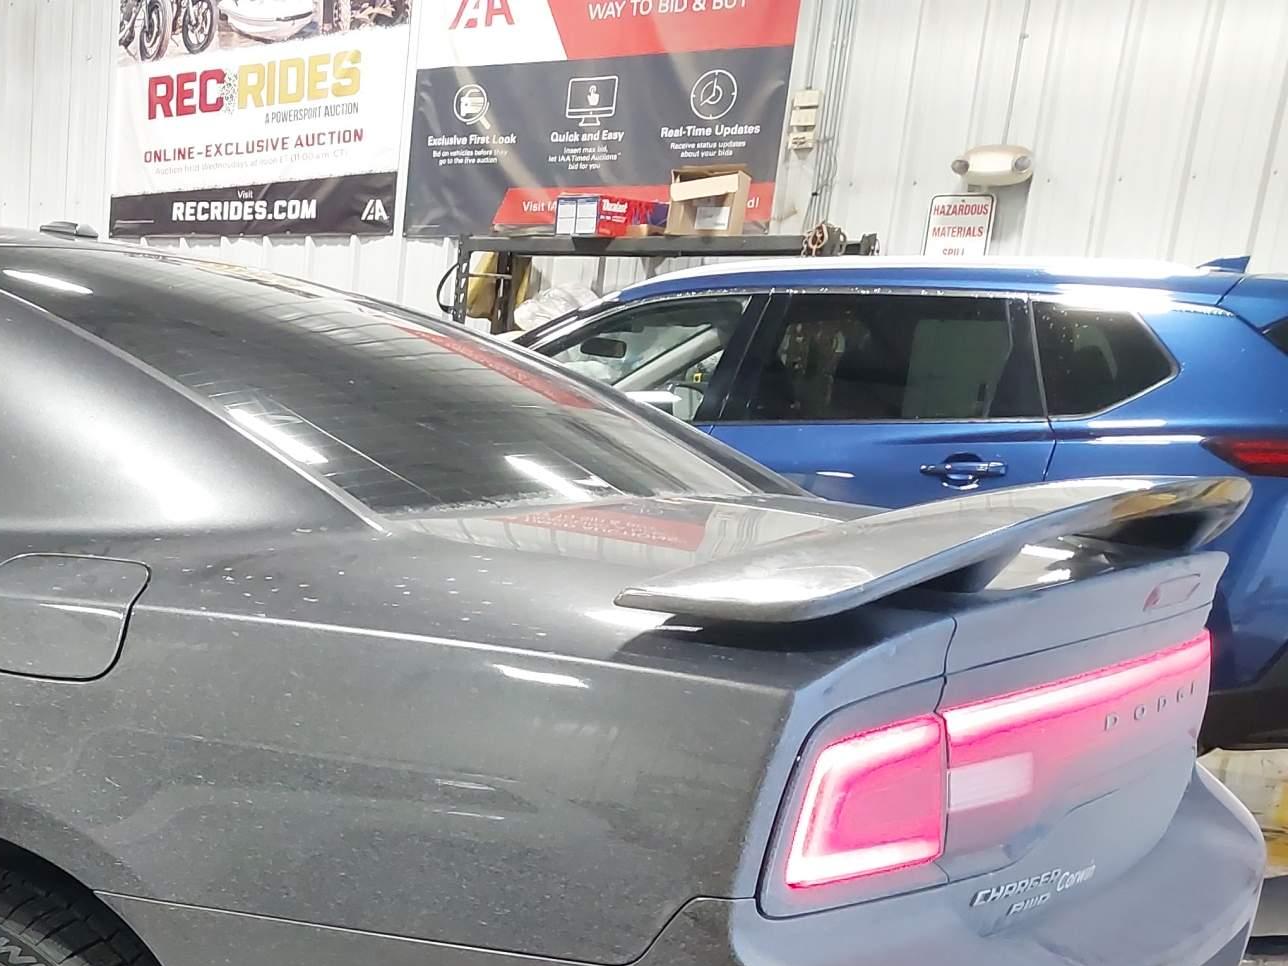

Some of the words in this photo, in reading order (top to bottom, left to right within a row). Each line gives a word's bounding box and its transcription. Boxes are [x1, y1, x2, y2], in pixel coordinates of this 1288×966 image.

[588, 1, 626, 20] WAY
[630, 0, 652, 17] TO
[658, 0, 688, 13] BID
[692, 0, 706, 12] &
[272, 106, 321, 123] POWERSPORT
[324, 102, 359, 118] AUCTION
[551, 131, 580, 142] Quick
[581, 130, 600, 141] and
[602, 129, 625, 142] Easy
[660, 126, 712, 138] Real-Time
[715, 124, 761, 137] Updates
[144, 136, 290, 163] ONLINE-EXCLUSIVE
[294, 128, 364, 148] AUCTION
[427, 134, 467, 146] Exclusive
[469, 134, 489, 145] First
[492, 133, 517, 144] Look
[237, 189, 253, 199] Visit
[172, 199, 317, 221] RECRIDES.COM
[523, 200, 545, 212] Visit
[933, 203, 989, 216] HAZARDOUS
[932, 226, 984, 238] MATERIALS
